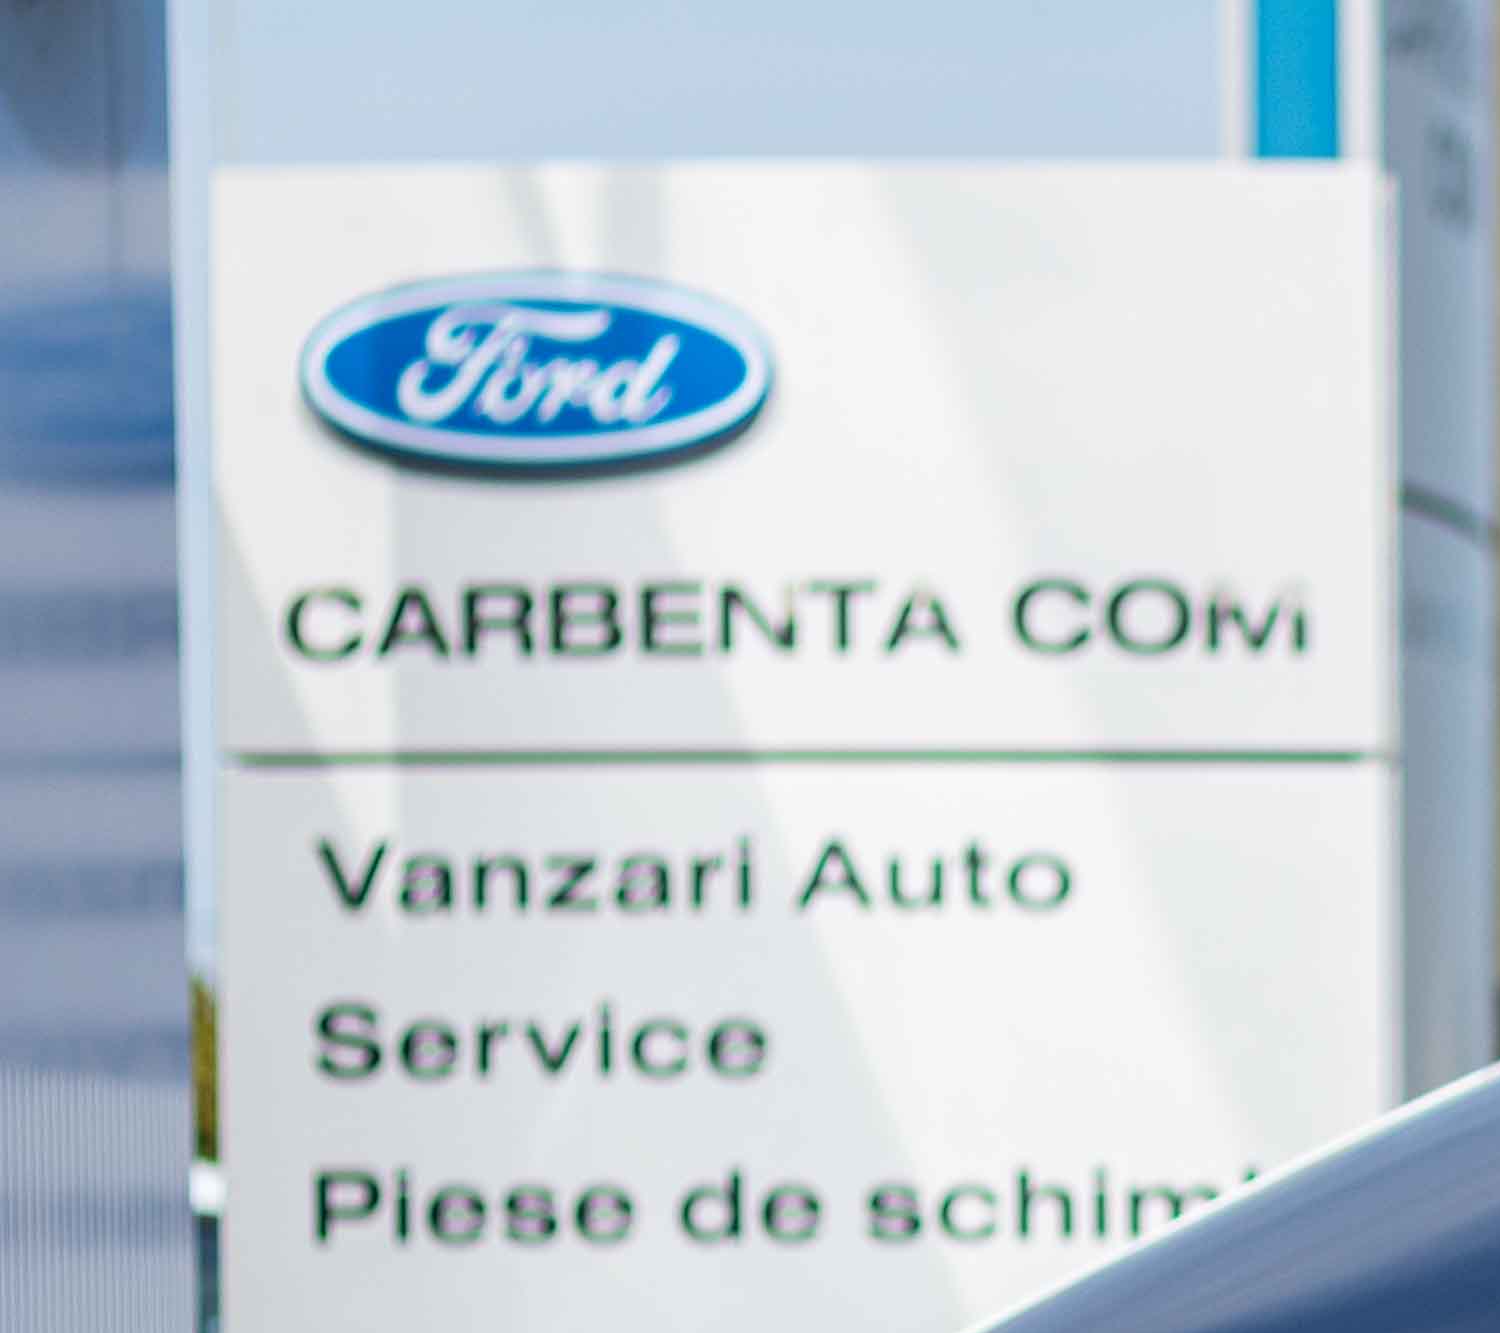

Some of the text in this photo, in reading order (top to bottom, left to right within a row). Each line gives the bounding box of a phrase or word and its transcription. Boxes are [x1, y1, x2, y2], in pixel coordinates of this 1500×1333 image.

[396, 302, 681, 425] Ford
[282, 577, 1310, 662] CARBENTA COM
[314, 835, 1074, 916] Vanzari Auto
[312, 1001, 769, 1083] Service
[312, 1166, 1258, 1248] Piese de schim
